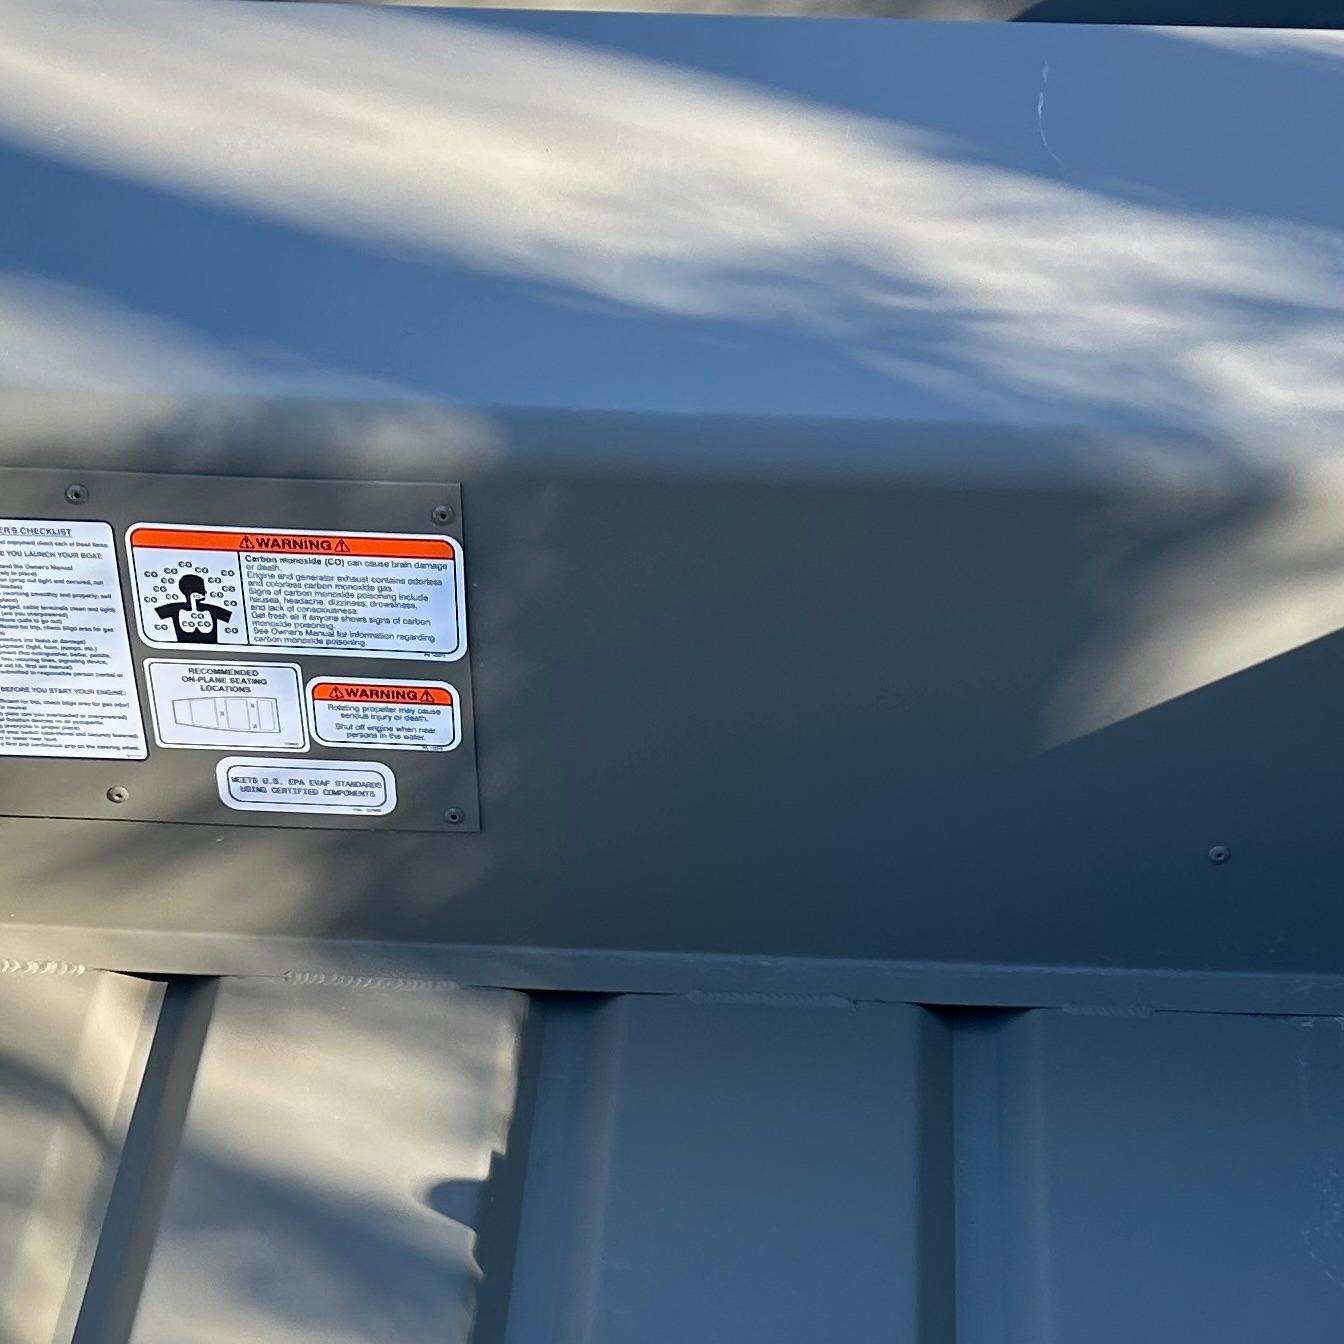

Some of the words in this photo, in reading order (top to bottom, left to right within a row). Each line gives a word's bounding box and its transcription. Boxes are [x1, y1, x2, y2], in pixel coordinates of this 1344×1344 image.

[20, 527, 73, 536] CHECKLIST
[256, 538, 332, 550] WARNING
[245, 555, 277, 563] Carbon
[279, 557, 322, 565] monoxide
[324, 558, 345, 567] (CO)
[392, 561, 412, 569] brain
[414, 562, 448, 571] damage
[247, 572, 276, 581] Engine
[296, 574, 335, 582] generator
[337, 575, 369, 583] exhaust
[371, 577, 405, 585] contains
[408, 578, 442, 586] odorless
[266, 580, 302, 588] colorless
[335, 583, 375, 591] monoxide
[249, 588, 272, 596] Signs
[315, 590, 354, 598] monoxide
[356, 592, 397, 601] poisoning
[309, 615, 339, 624] anyone
[341, 615, 367, 623] shows
[369, 617, 391, 625] signs
[402, 618, 431, 626] carbon
[349, 632, 394, 640] information
[397, 634, 435, 643] regarding
[188, 668, 259, 676] RECOMMENDED
[182, 676, 227, 684] ON-PLANE
[200, 685, 251, 693] LOCATIONS
[346, 688, 417, 700] WARNING
[328, 704, 359, 712] Rotating
[362, 706, 396, 714] propeller
[367, 725, 394, 733] engine
[272, 787, 318, 795] CERTIFIED
